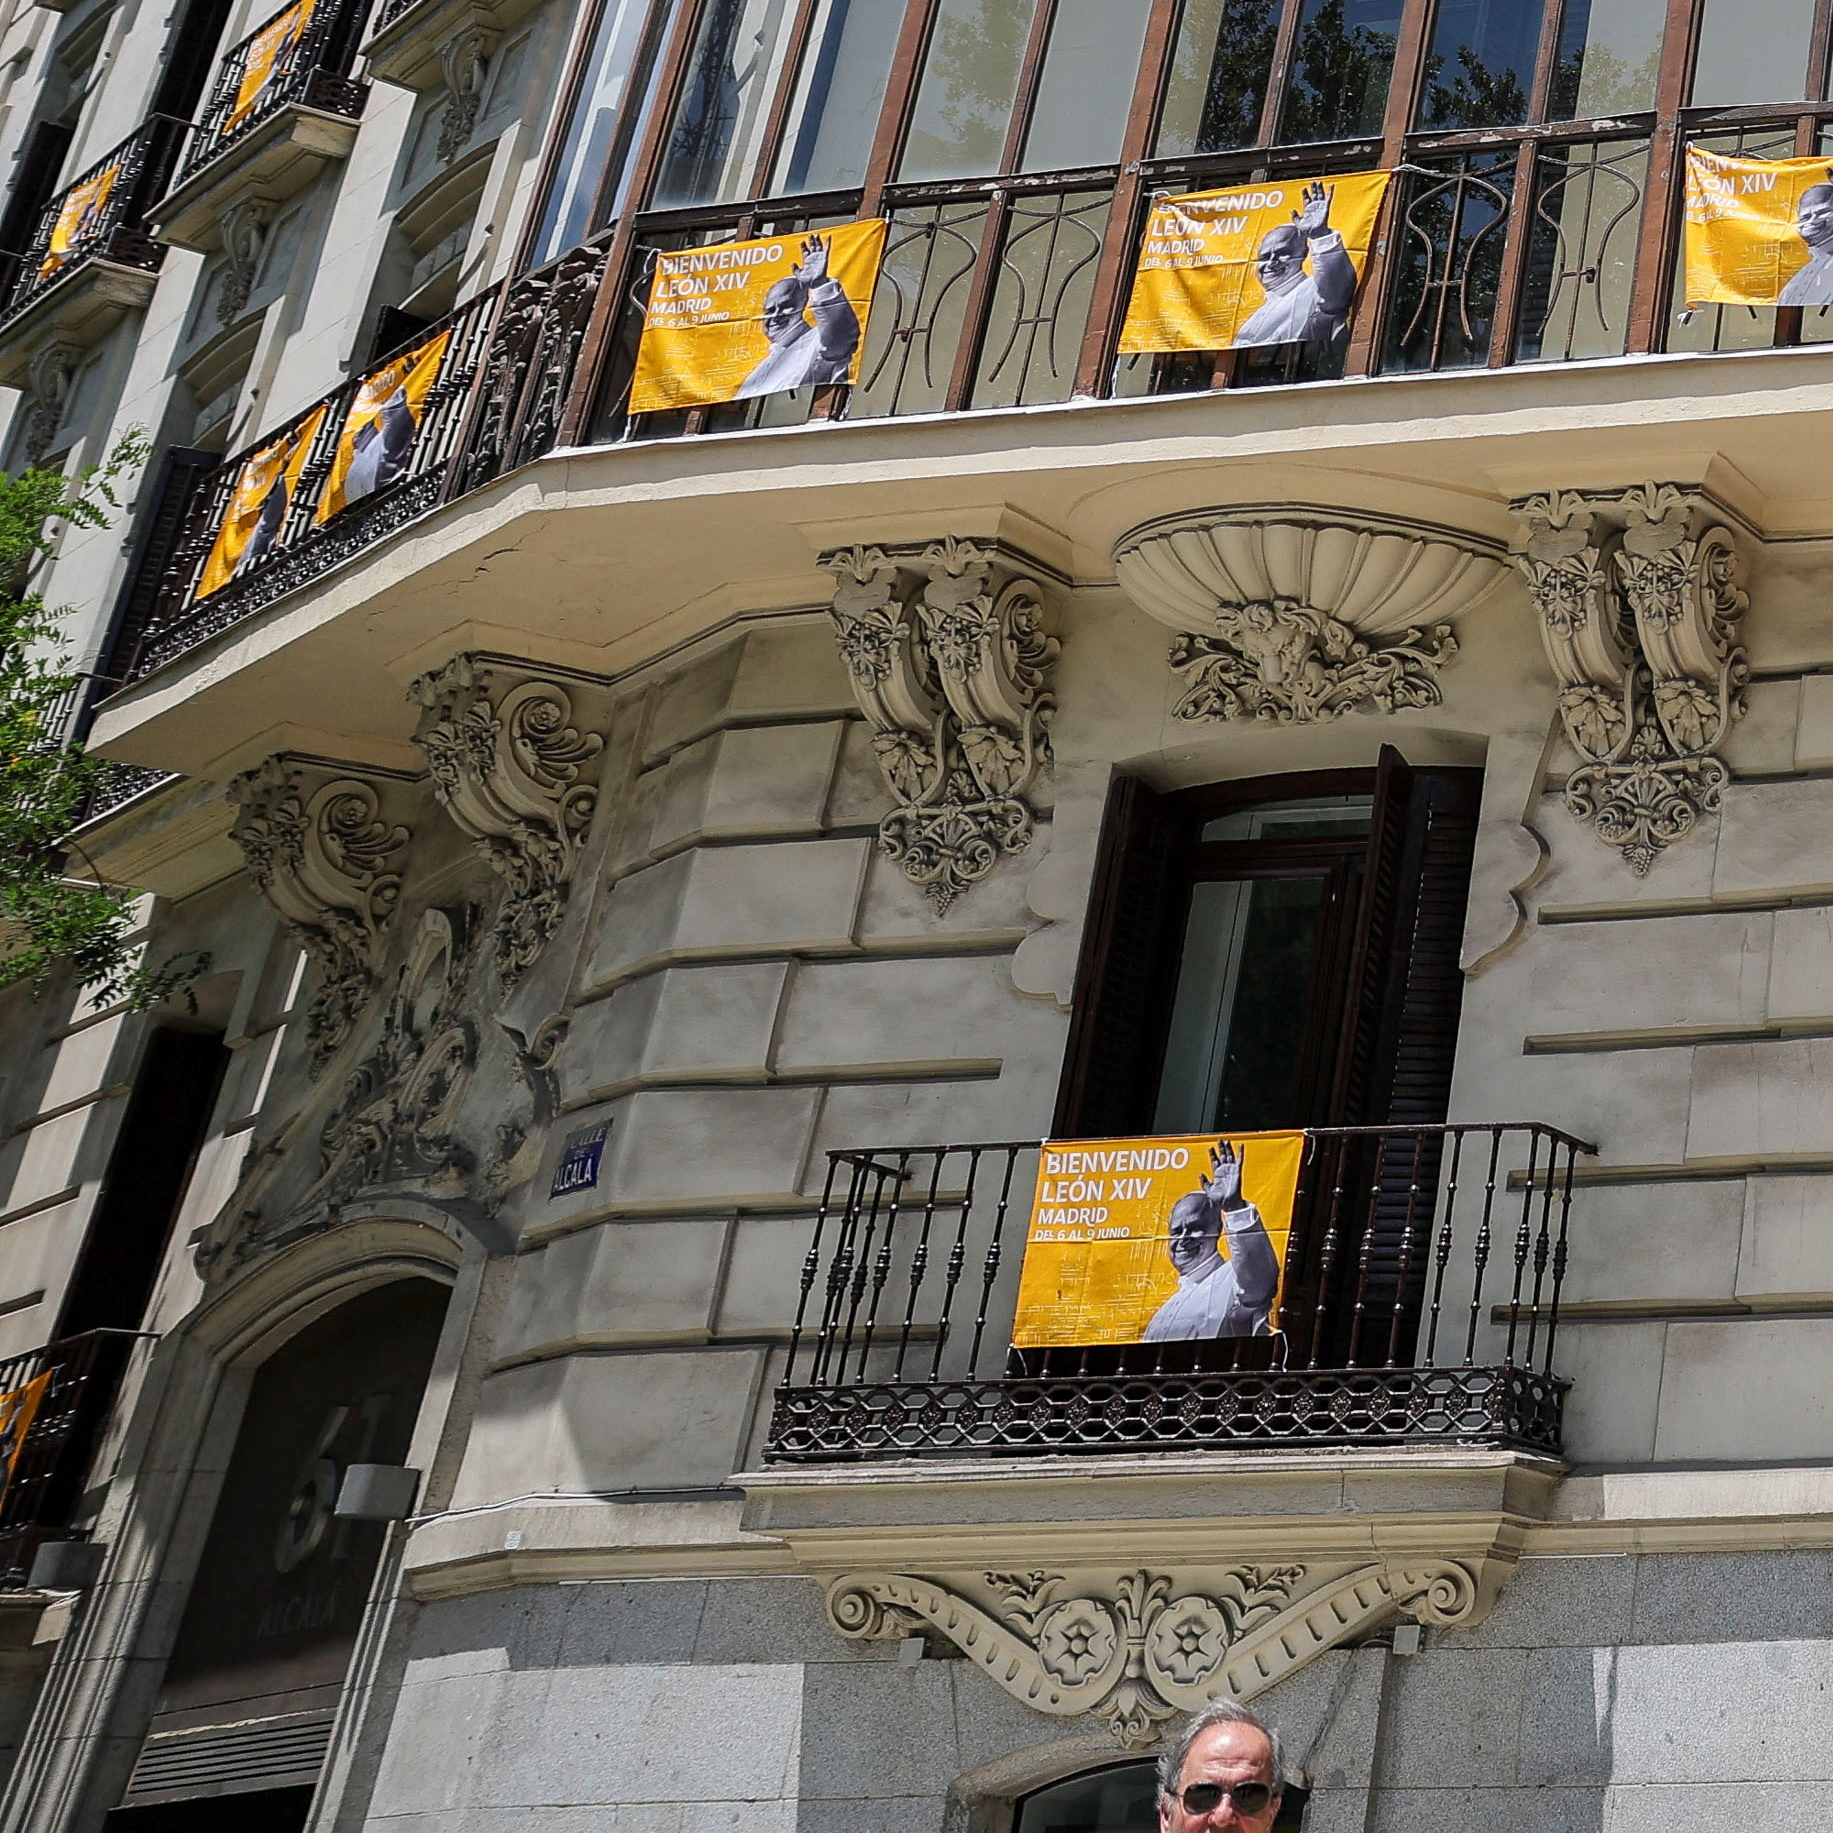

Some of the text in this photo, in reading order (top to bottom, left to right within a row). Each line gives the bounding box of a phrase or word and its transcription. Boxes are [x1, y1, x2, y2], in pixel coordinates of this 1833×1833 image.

[1741, 172, 1778, 194] XIV
[1208, 215, 1249, 236] XIV
[1147, 238, 1206, 256] MADRID
[662, 244, 784, 277] BIENVENIDO
[1144, 257, 1163, 267] DEL
[1164, 257, 1173, 267] 6
[1175, 256, 1187, 267] AL
[1195, 254, 1225, 266] JUNIO
[655, 271, 752, 299] LEÓN XIV
[652, 297, 711, 317] MADRID
[649, 316, 666, 327] DEL
[667, 316, 676, 327] 6
[678, 315, 691, 326] AL
[700, 311, 731, 324] JUNIO
[1044, 1147, 1190, 1175] BIENVENIDO
[551, 1153, 592, 1192] ALCALÁ
[1041, 1176, 1152, 1203] LEÓN XIV
[1036, 1206, 1108, 1227] MADRID
[1034, 1226, 1130, 1243] DEL 6 AL 9 JUNIO
[273, 1392, 391, 1573] 61
